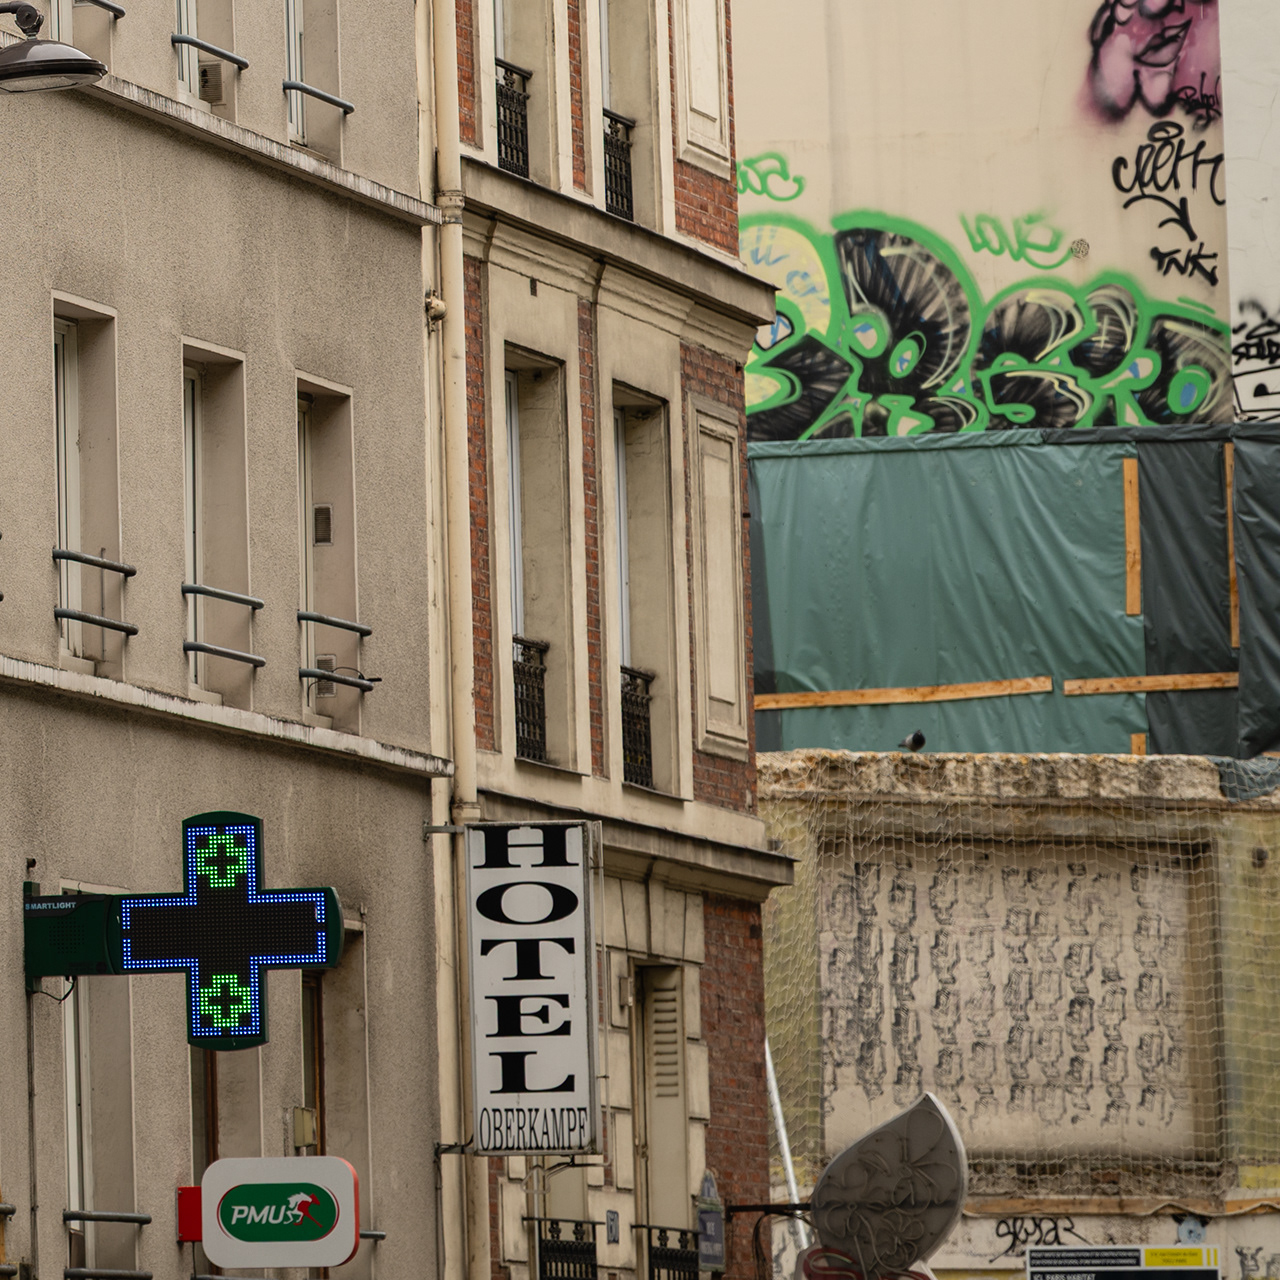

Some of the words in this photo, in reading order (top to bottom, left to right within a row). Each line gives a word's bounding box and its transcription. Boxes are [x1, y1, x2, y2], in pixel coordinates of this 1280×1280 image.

[25, 901, 77, 910] SMARTLIGHT
[472, 825, 580, 1095] HOTEL
[479, 1107, 588, 1152] OBERKAMPF
[231, 1205, 287, 1225] PMU
